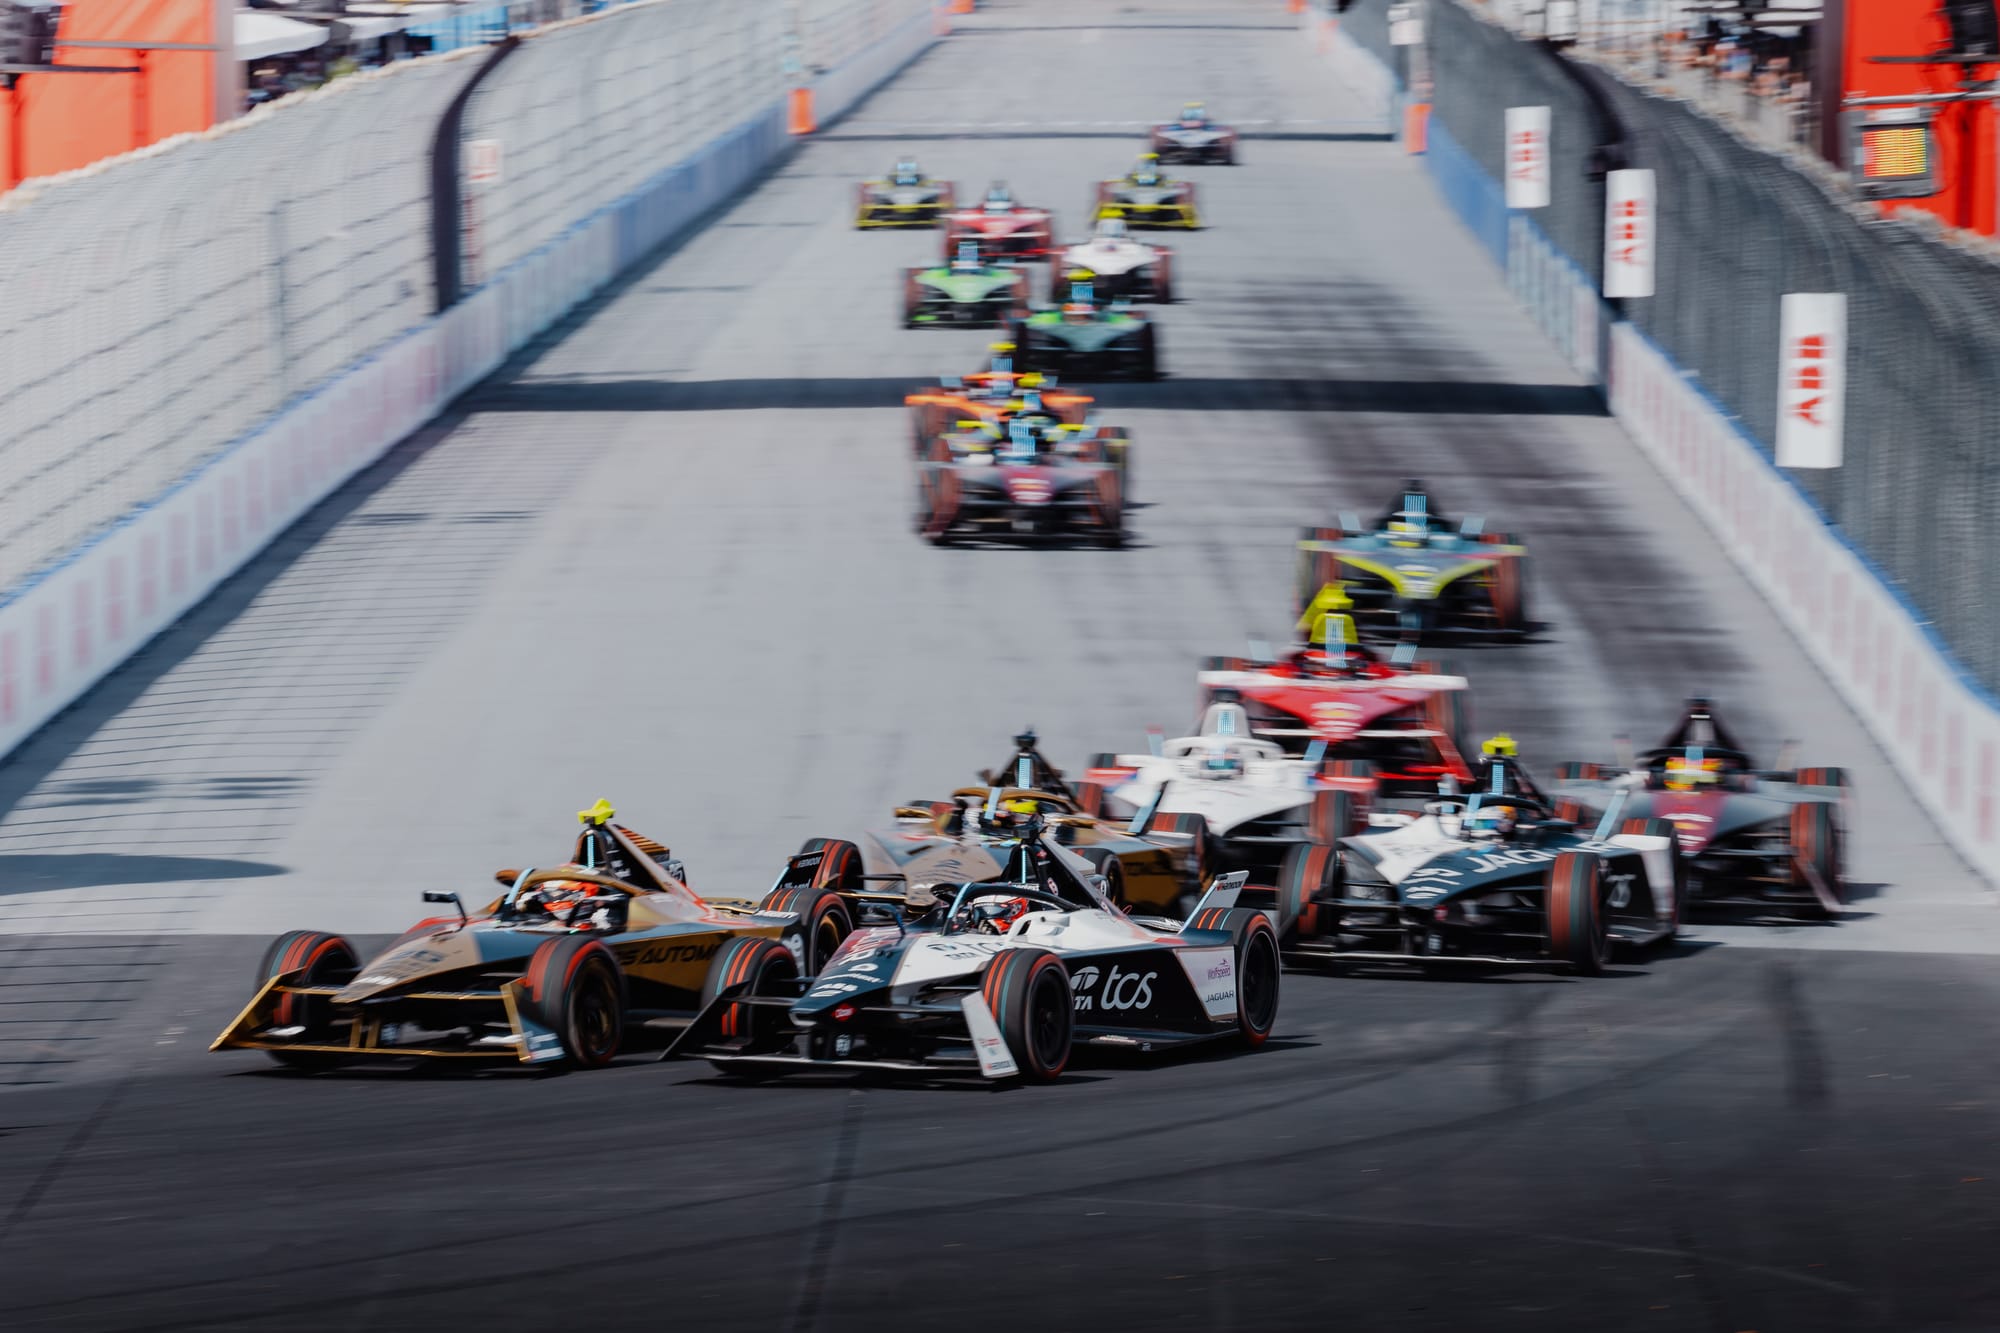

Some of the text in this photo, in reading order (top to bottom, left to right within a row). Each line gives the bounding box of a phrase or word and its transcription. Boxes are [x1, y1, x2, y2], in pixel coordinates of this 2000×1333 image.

[1789, 335, 1829, 428] ABB
[1100, 964, 1158, 1010] tcs
[1205, 990, 1234, 1003] JAGUAR
